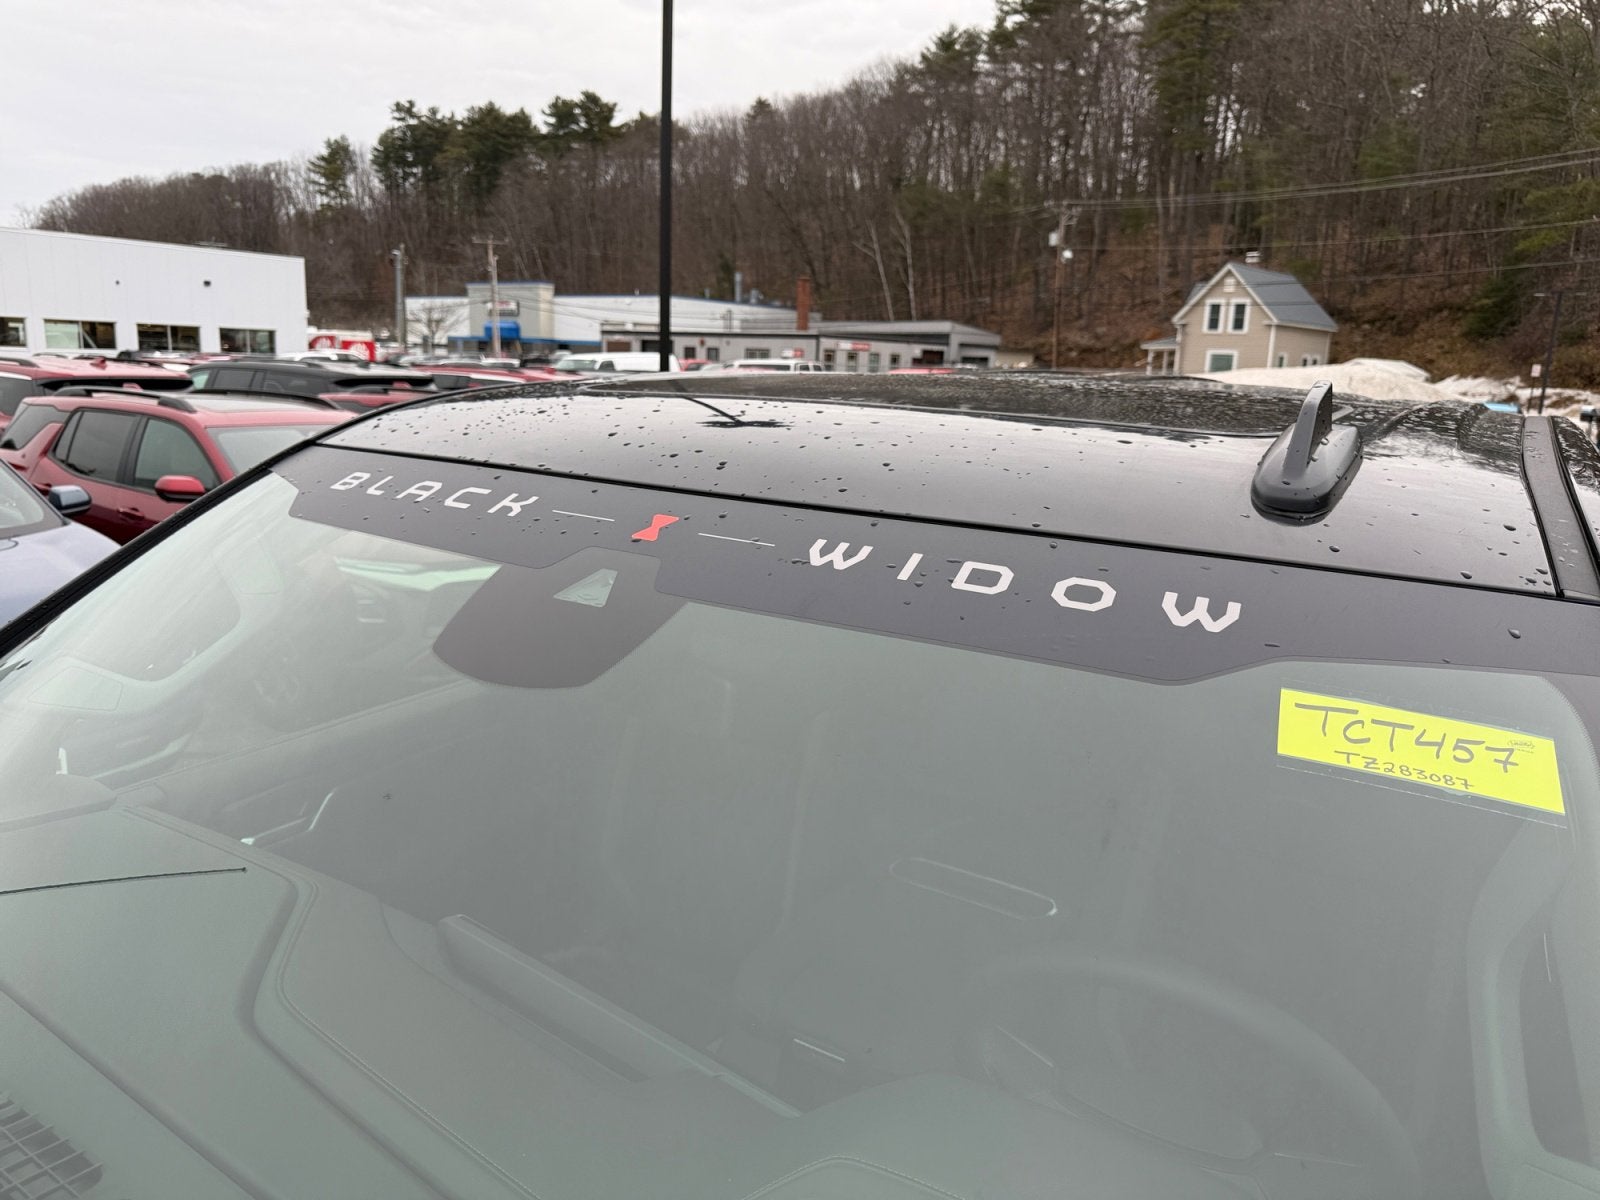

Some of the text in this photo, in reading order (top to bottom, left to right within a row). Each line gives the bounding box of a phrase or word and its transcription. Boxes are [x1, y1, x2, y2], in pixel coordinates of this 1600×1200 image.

[330, 471, 1242, 633] BLACK WIDOW
[1294, 702, 1519, 773] TCT457
[1334, 750, 1475, 790] TZ283087
